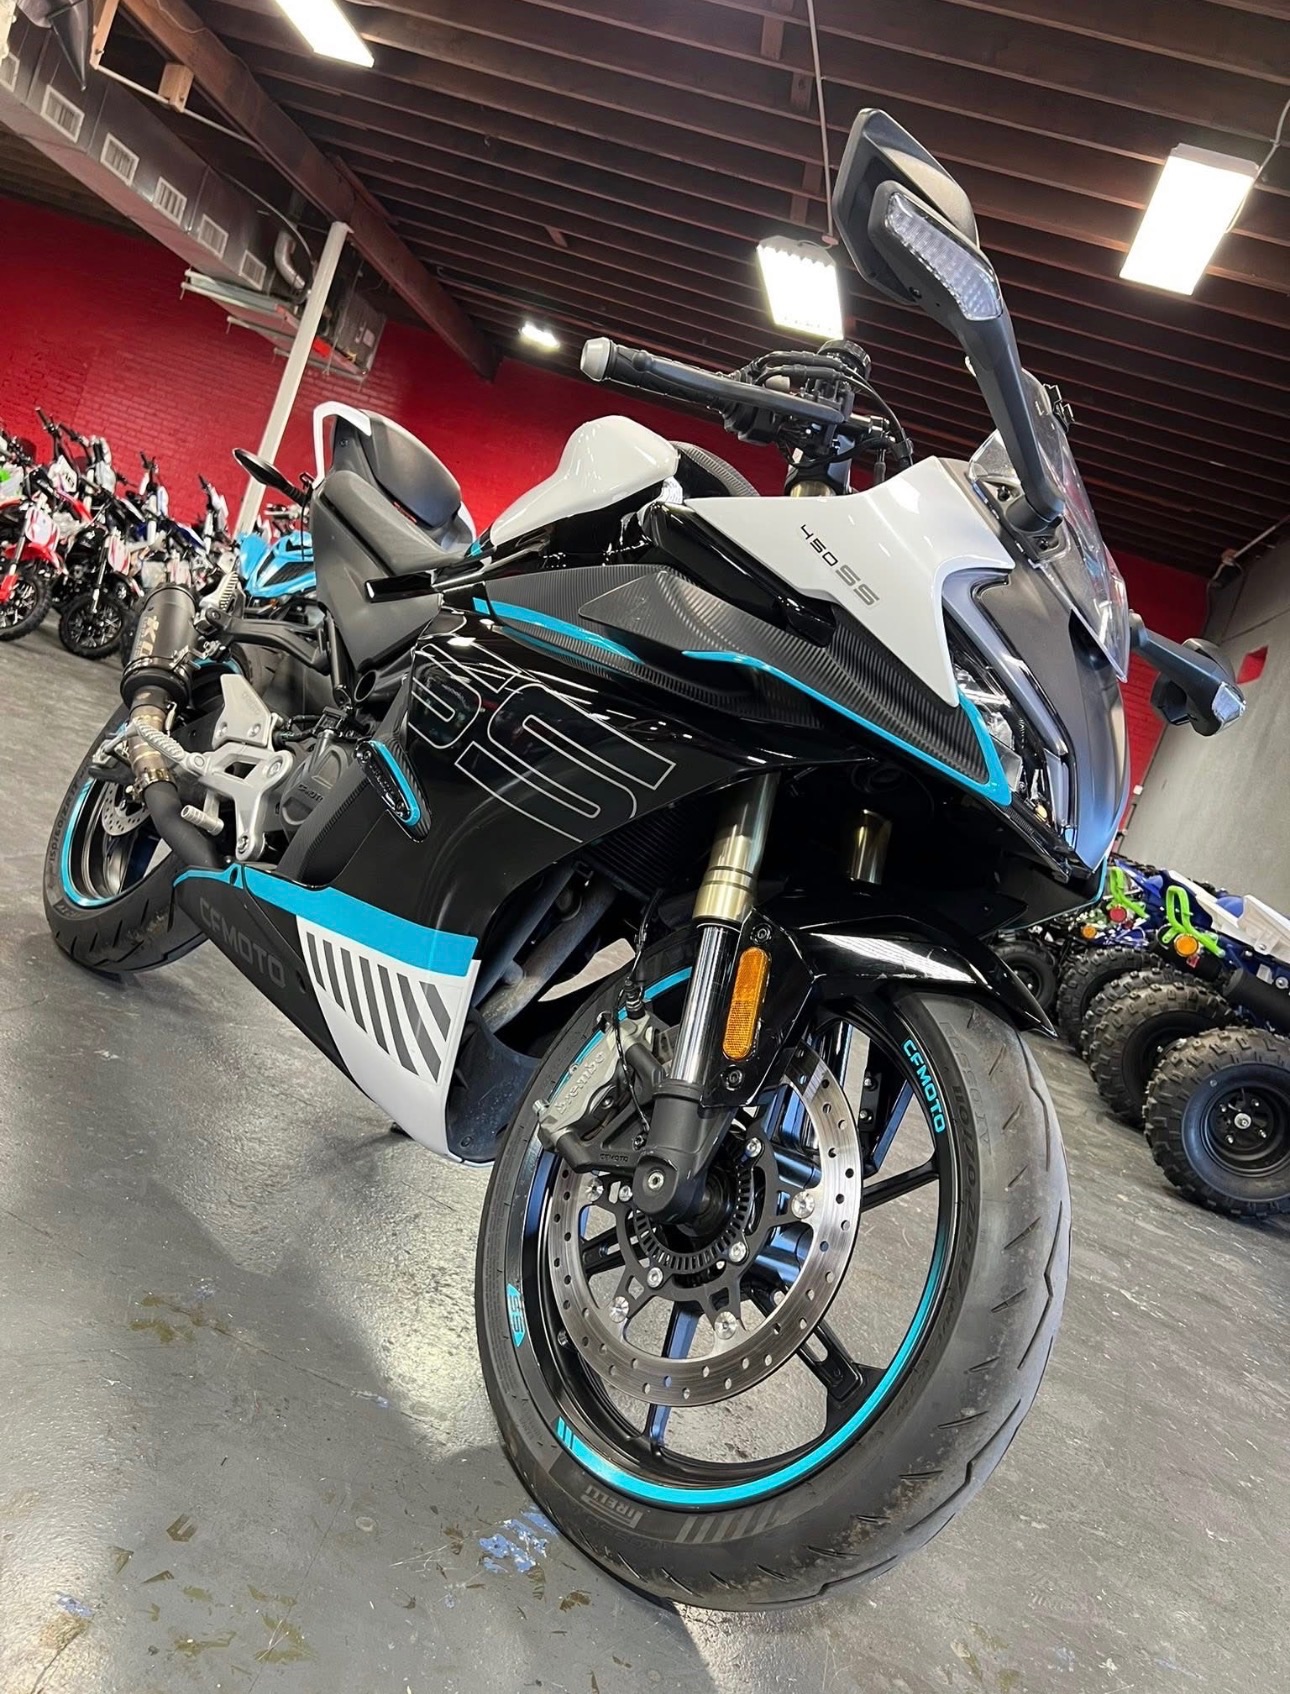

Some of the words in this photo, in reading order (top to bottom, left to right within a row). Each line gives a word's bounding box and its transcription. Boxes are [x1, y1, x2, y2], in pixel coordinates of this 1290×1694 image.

[200, 897, 286, 989] CFMOTO
[554, 1051, 605, 1115] brembo
[903, 1039, 946, 1133] CFMOTO
[581, 1484, 643, 1529] PIRELLI
